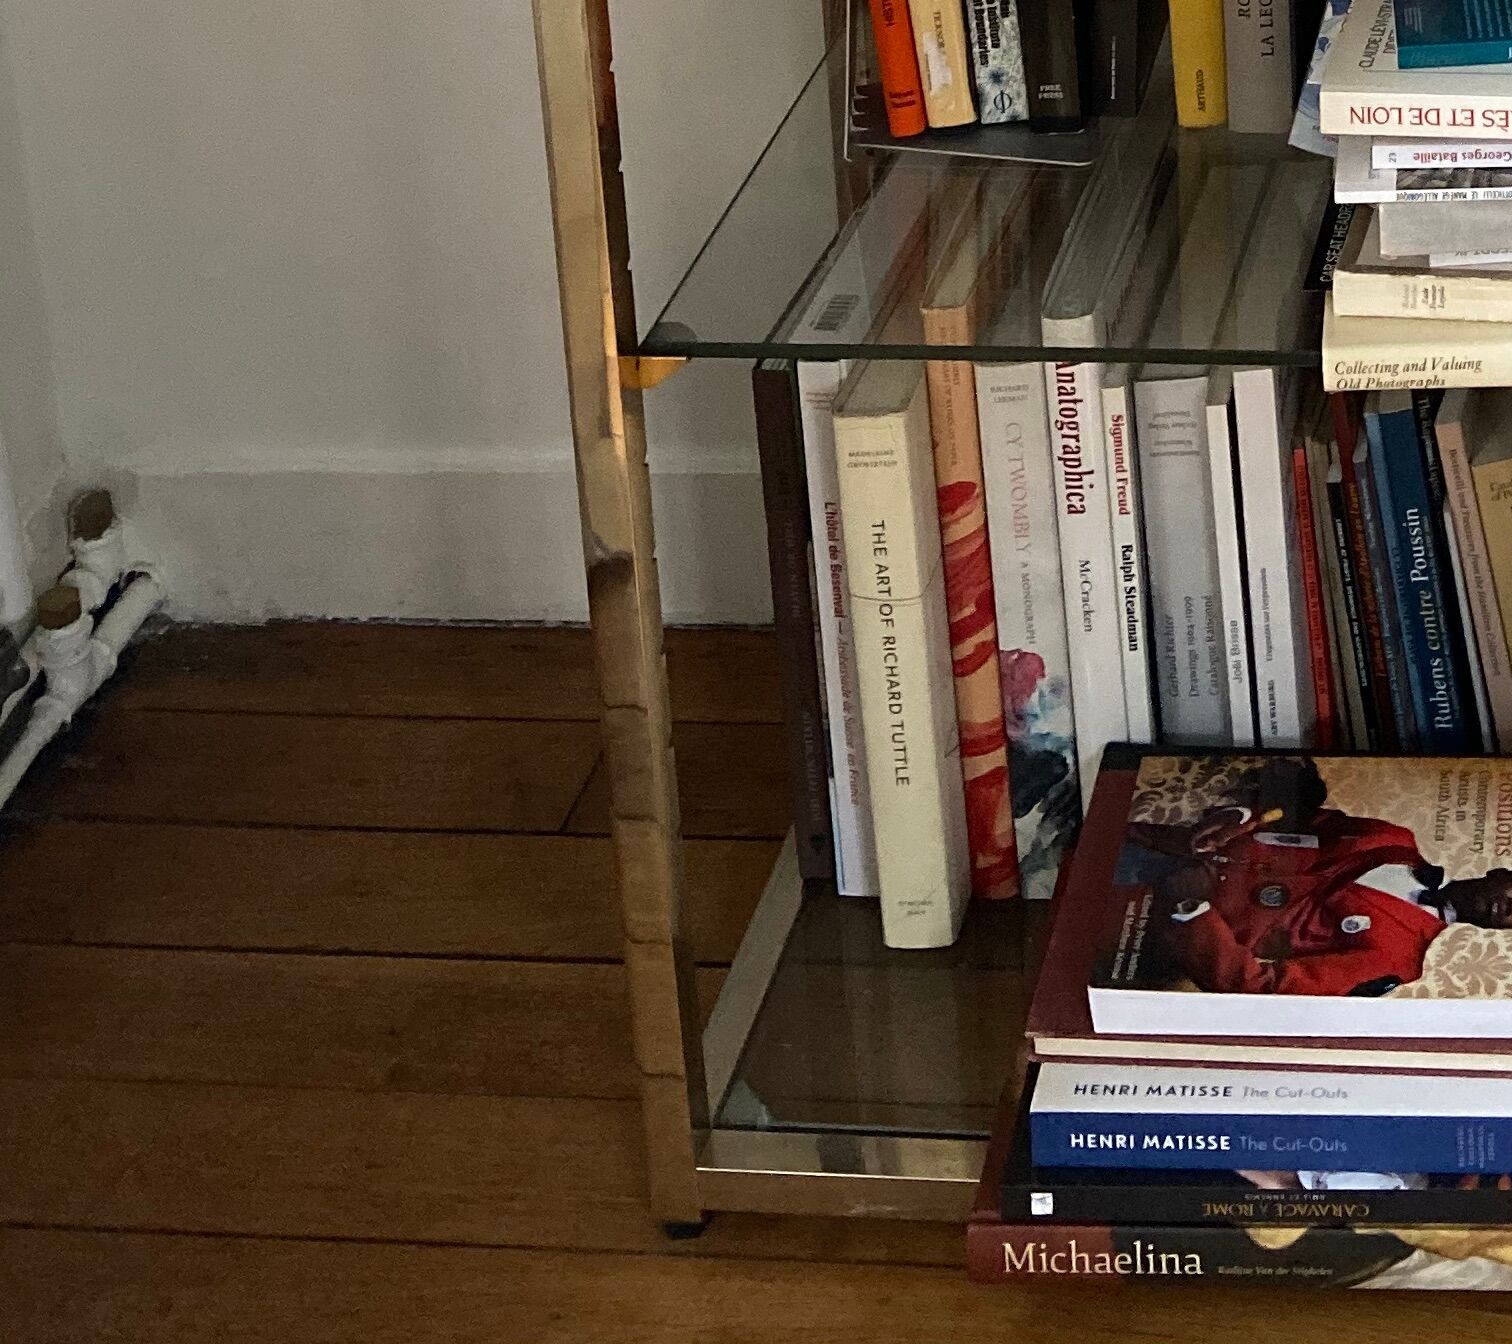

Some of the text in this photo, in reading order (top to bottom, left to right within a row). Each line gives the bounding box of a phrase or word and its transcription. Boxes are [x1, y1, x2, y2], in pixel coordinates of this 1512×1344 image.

[973, 8, 990, 66] Boundaries
[986, 6, 1003, 49] Institute
[1261, 33, 1274, 57] LA
[1348, 106, 1403, 126] LOIN
[1407, 108, 1441, 127] DE
[1446, 108, 1475, 128] ET
[1412, 148, 1512, 164] Georges Bataille
[1333, 355, 1483, 377] Collecting and Valuing
[1107, 414, 1133, 516] Sigmund Freud
[1077, 559, 1096, 633] McCracken
[1118, 544, 1141, 651] Ralph Steadman
[1399, 506, 1453, 730] Rubens contre Poussin
[868, 519, 911, 787] THE ART OF RICHARD TUTTLE
[1073, 1083, 1349, 1101] HENRI MATISSE The Cut-Outs
[1070, 1133, 1349, 1155] HENRI MATISSE The Cut-Outs
[1002, 1240, 1204, 1276] Michaelina
